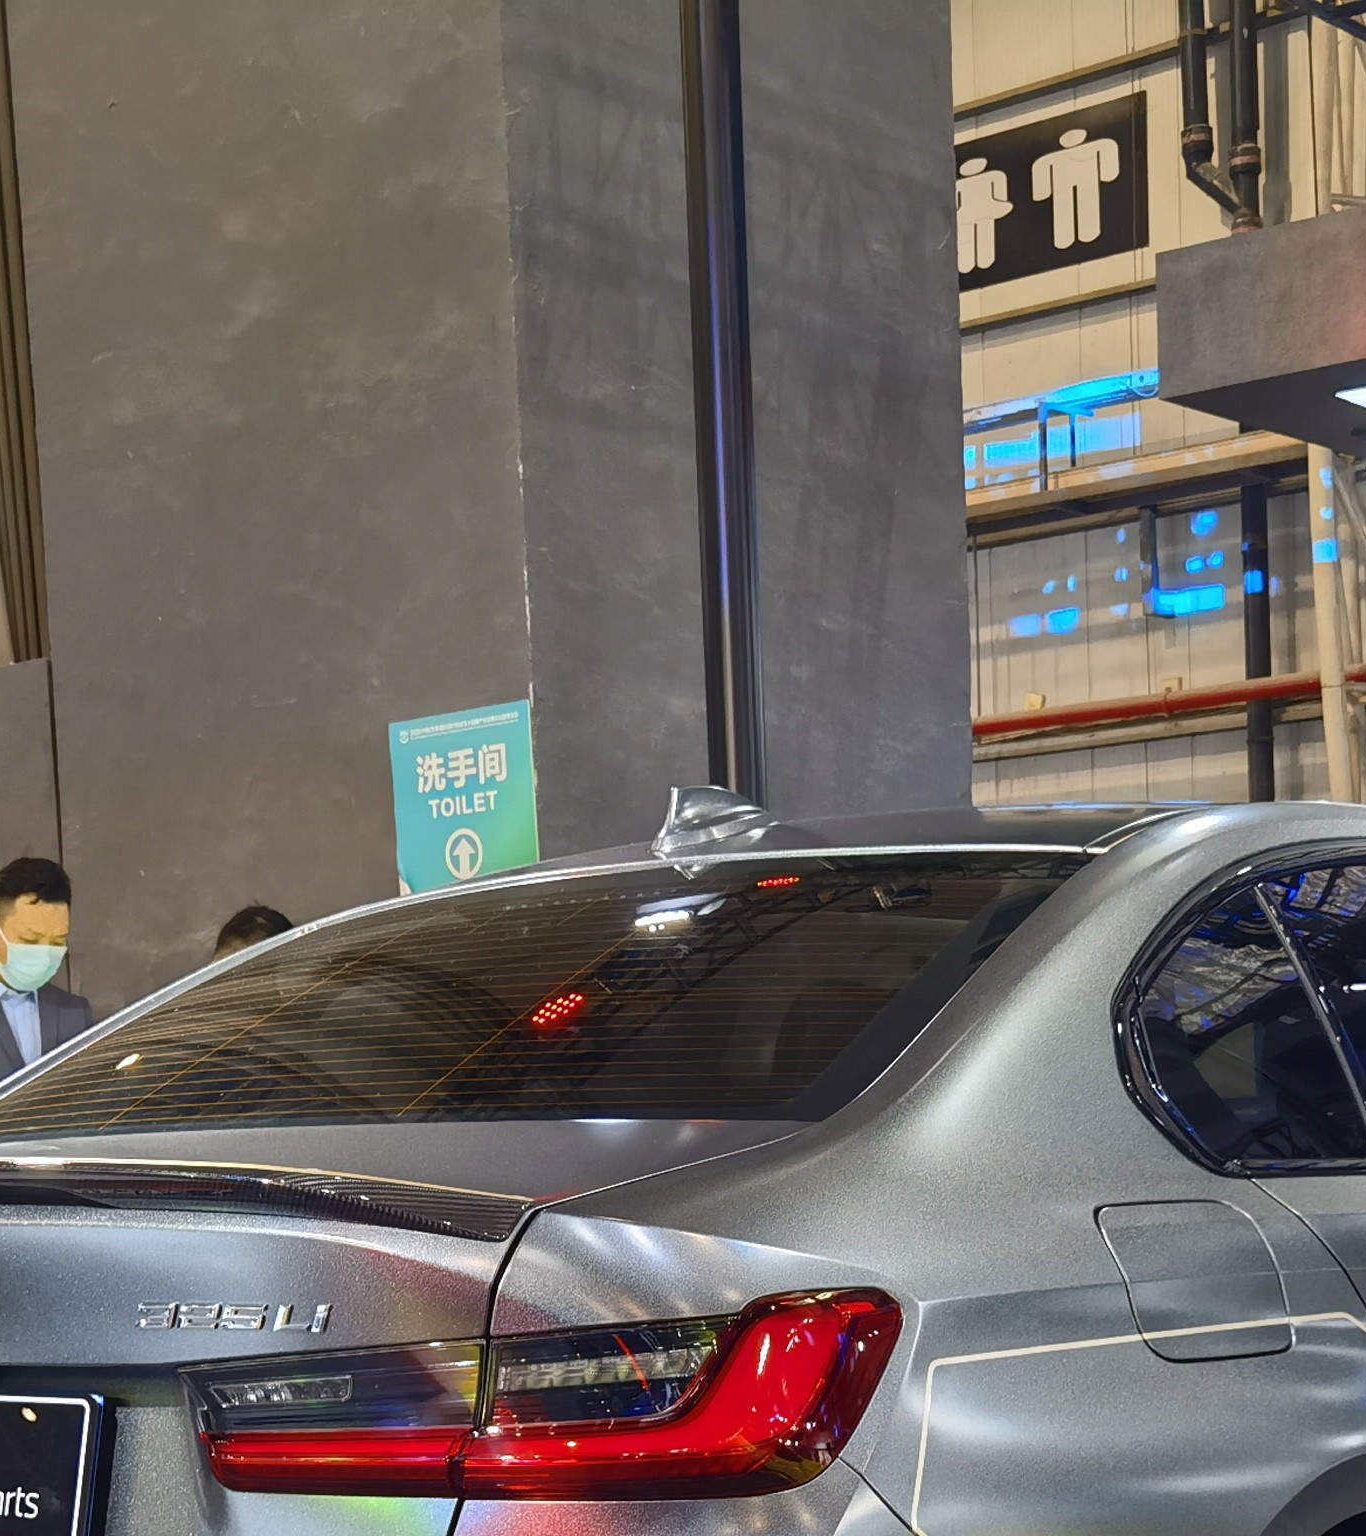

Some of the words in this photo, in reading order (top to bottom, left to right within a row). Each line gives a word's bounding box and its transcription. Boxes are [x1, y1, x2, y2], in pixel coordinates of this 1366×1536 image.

[416, 743, 508, 794] 洗手间
[428, 790, 498, 819] TOILET
